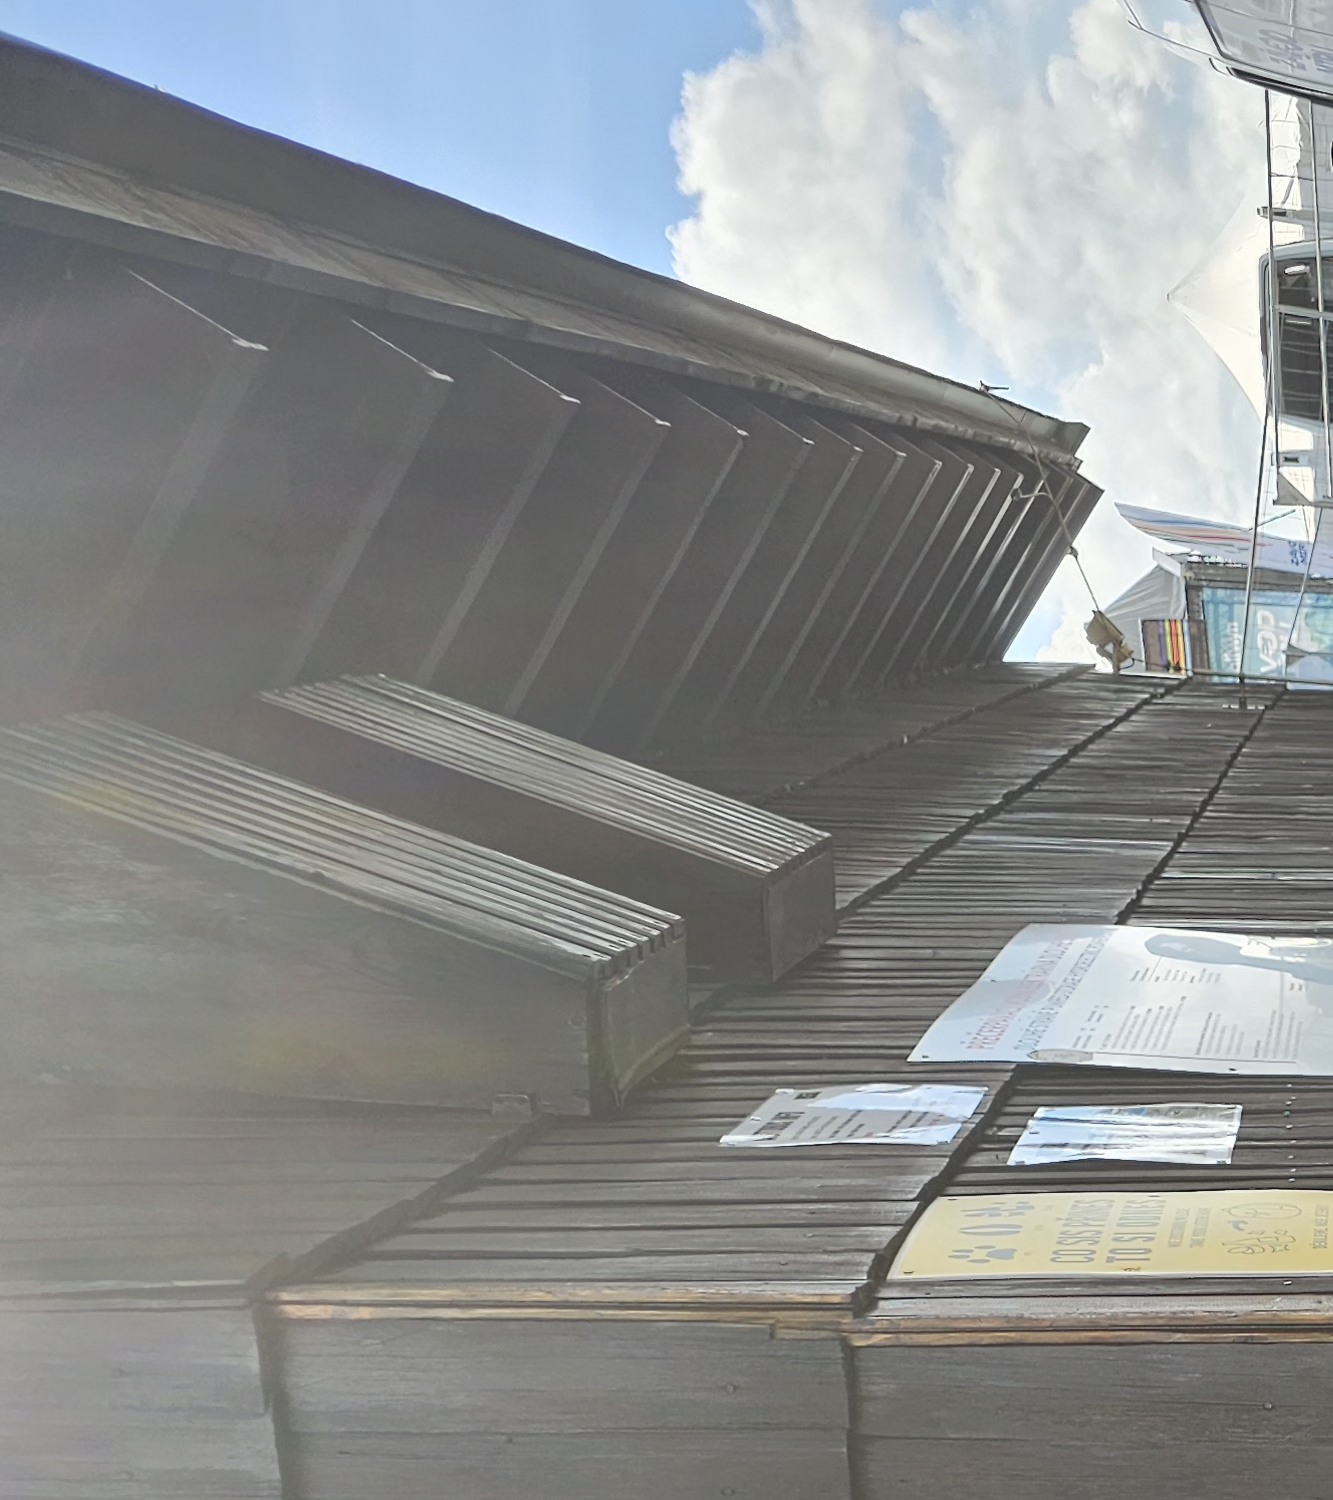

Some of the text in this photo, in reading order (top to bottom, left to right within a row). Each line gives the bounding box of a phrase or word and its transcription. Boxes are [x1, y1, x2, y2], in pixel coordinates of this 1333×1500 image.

[1049, 1198, 1116, 1264] CO SIS PŘINES
[1105, 1198, 1167, 1264] TO SI ODNES
